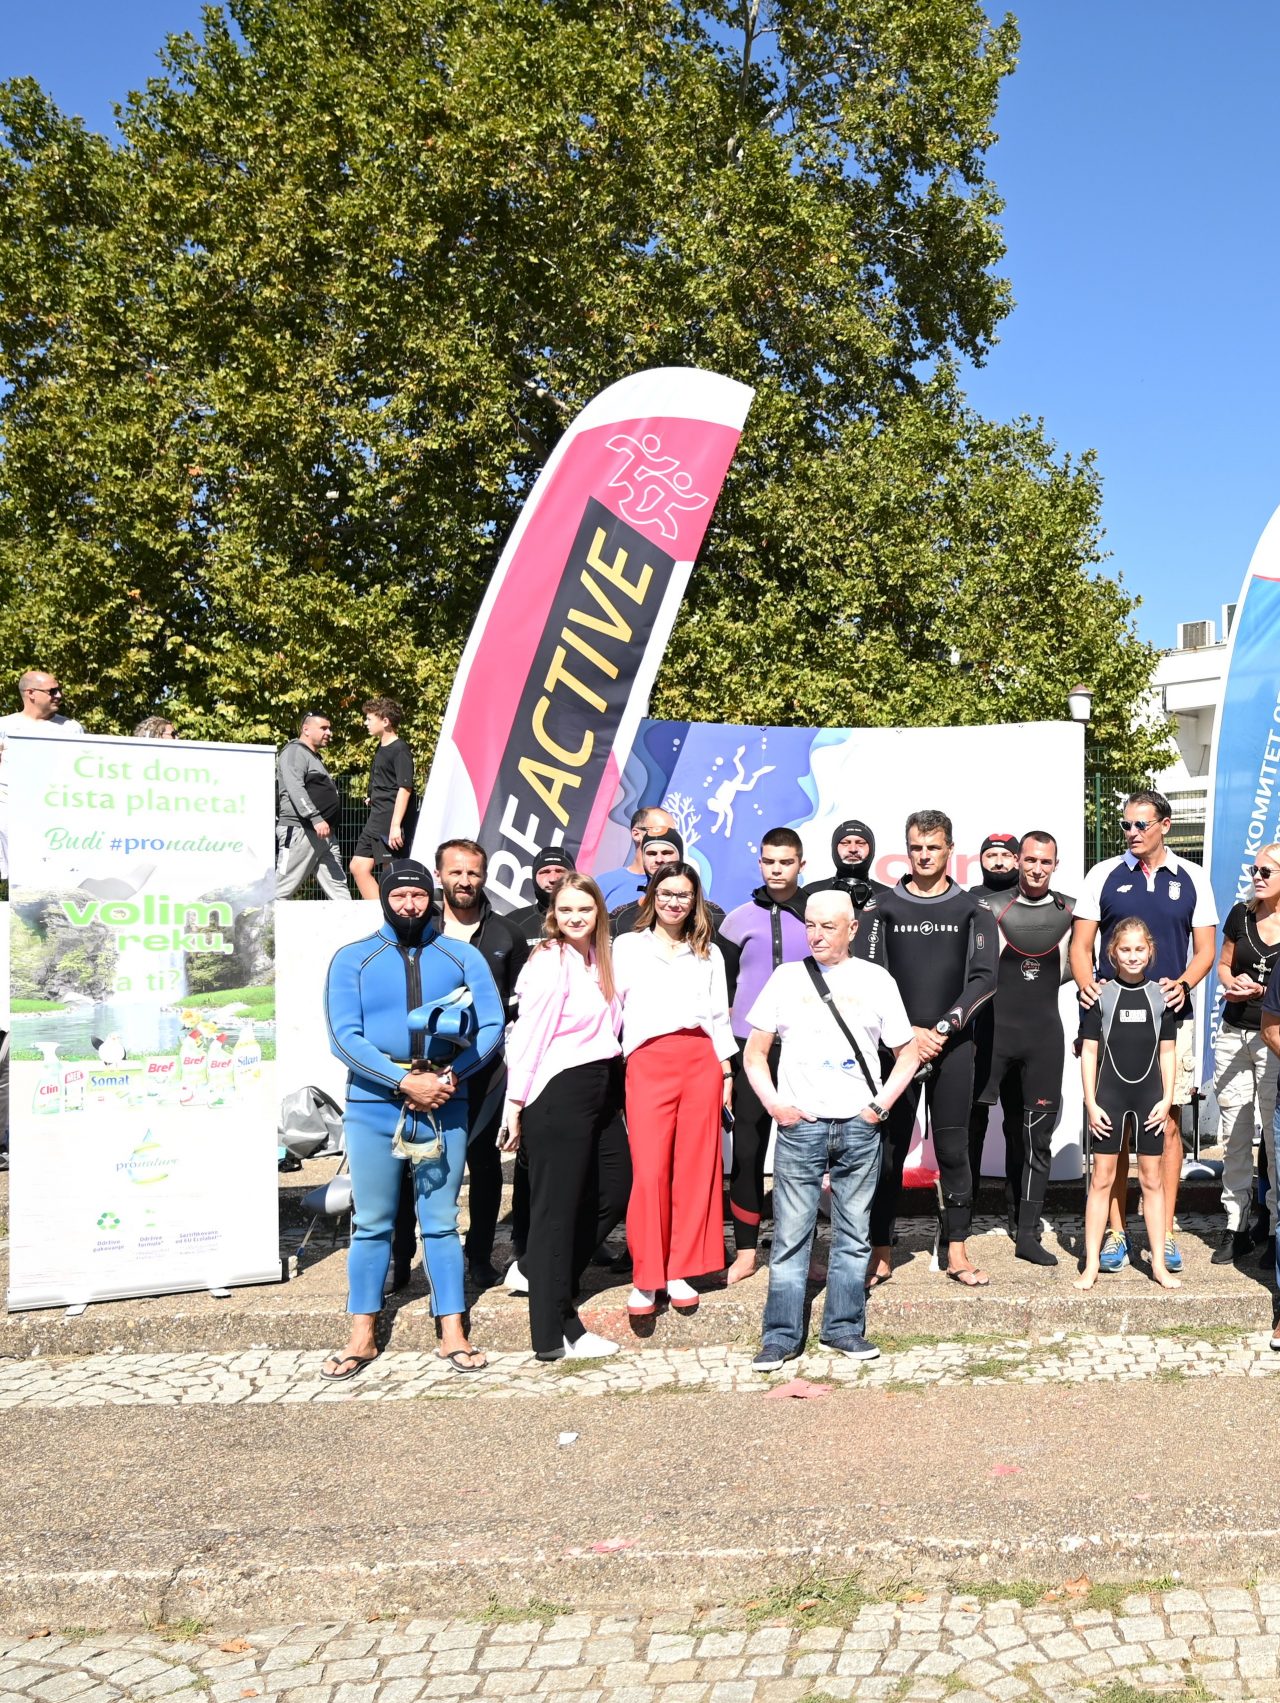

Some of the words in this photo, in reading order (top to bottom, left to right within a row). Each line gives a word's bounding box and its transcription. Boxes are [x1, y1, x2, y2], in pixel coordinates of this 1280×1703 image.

[483, 527, 653, 912] BEACTIVE
[74, 751, 132, 779] Čist
[143, 759, 219, 785] dom,
[44, 784, 115, 809] čista
[127, 788, 245, 816] planeta!
[44, 827, 105, 850] Budi
[110, 835, 244, 854] #pronature
[62, 895, 232, 925] volim
[934, 924, 959, 932] LUNG
[118, 929, 233, 953] reku,
[116, 977, 132, 991] a
[146, 969, 180, 990] ti?
[148, 1062, 174, 1073] Bref
[183, 1056, 205, 1066] Bref
[210, 1059, 232, 1069] Bref
[237, 1056, 258, 1067] Silan
[91, 1075, 129, 1087] Somat
[39, 1085, 59, 1095] Clin
